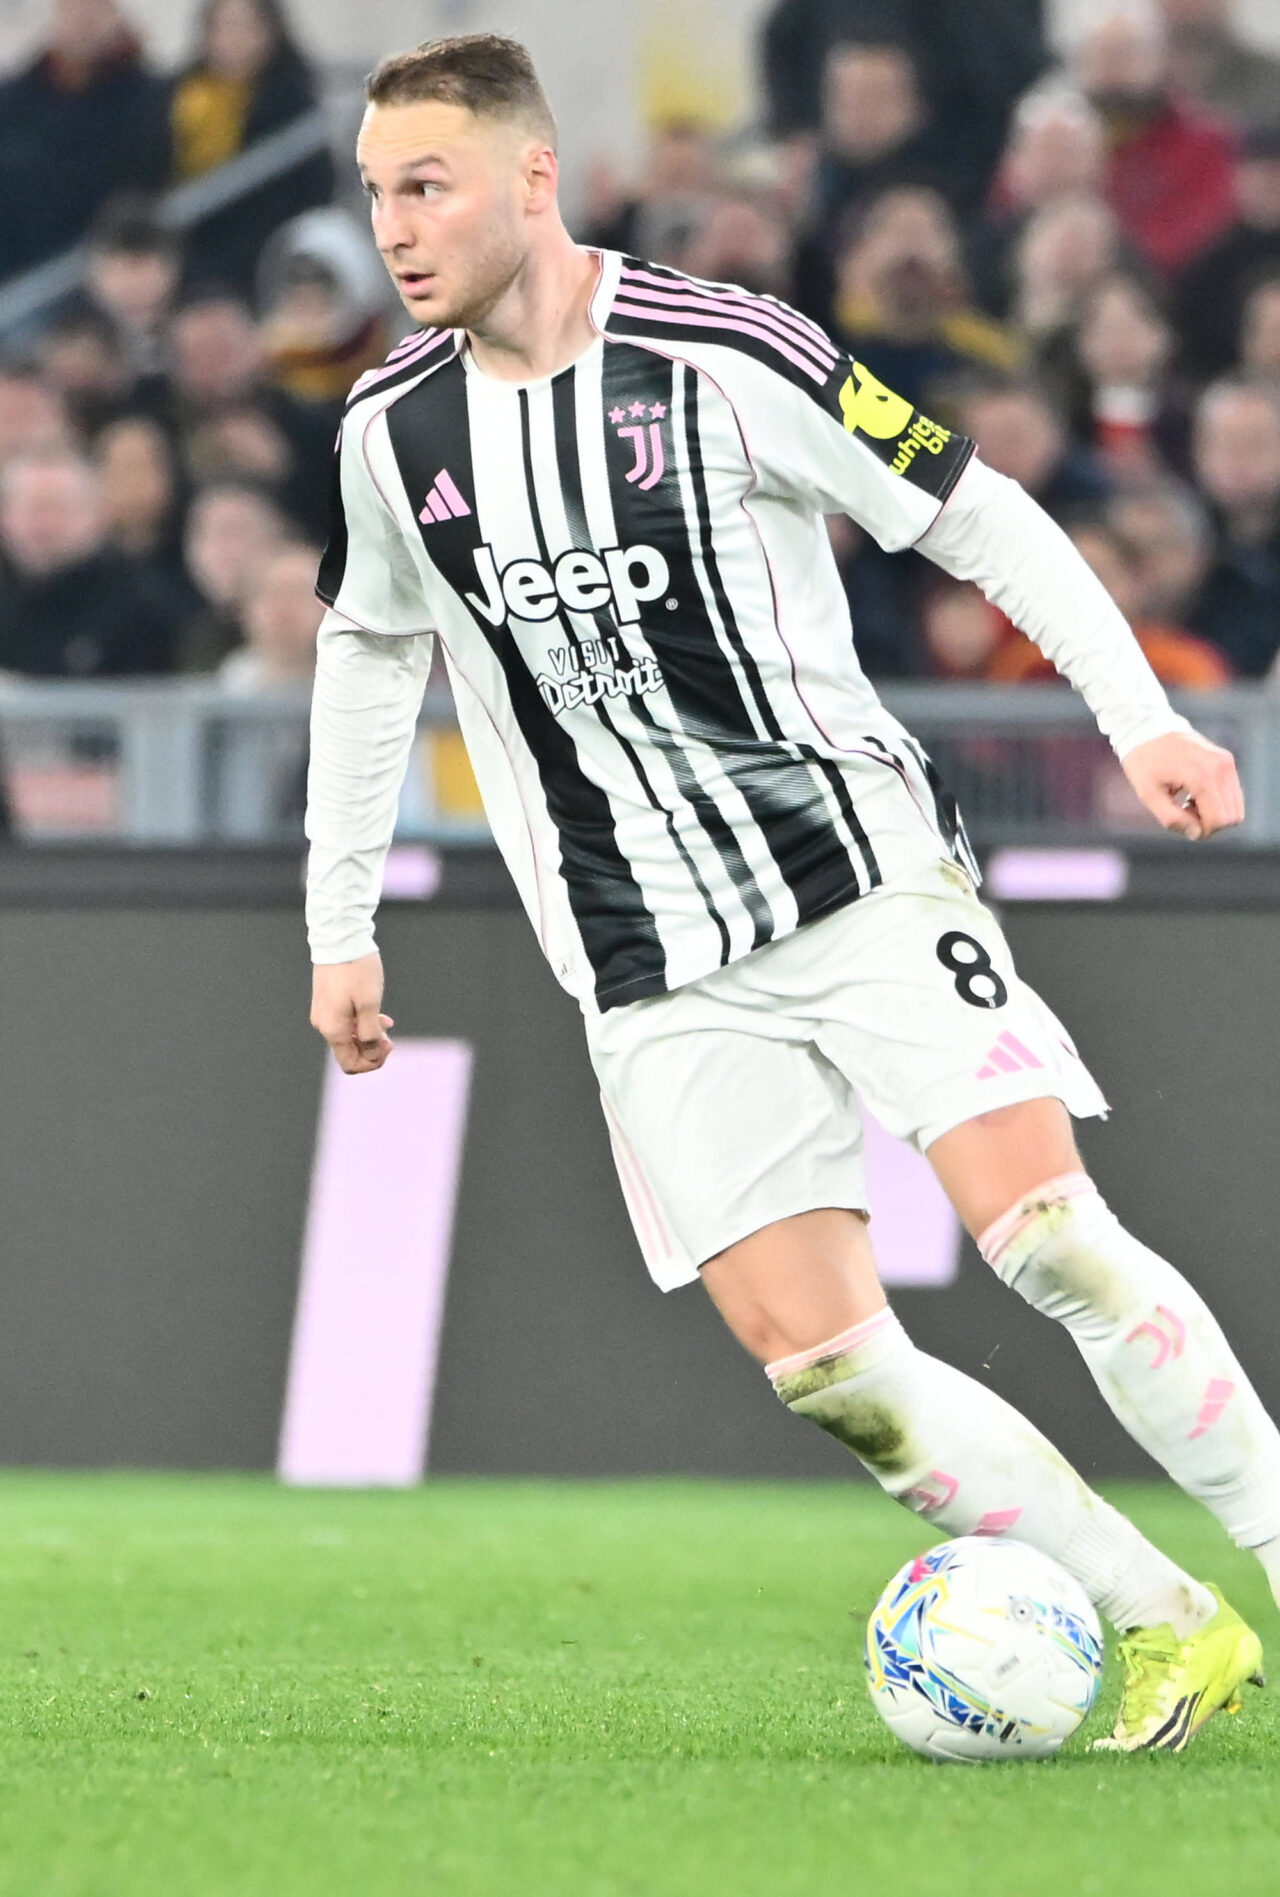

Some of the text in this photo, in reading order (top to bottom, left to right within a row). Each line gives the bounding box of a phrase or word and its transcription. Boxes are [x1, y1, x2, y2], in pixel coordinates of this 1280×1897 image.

[464, 542, 670, 627] Jeep
[536, 657, 664, 717] Detroit
[548, 636, 620, 676] VISIT
[936, 930, 1008, 1010] 8
